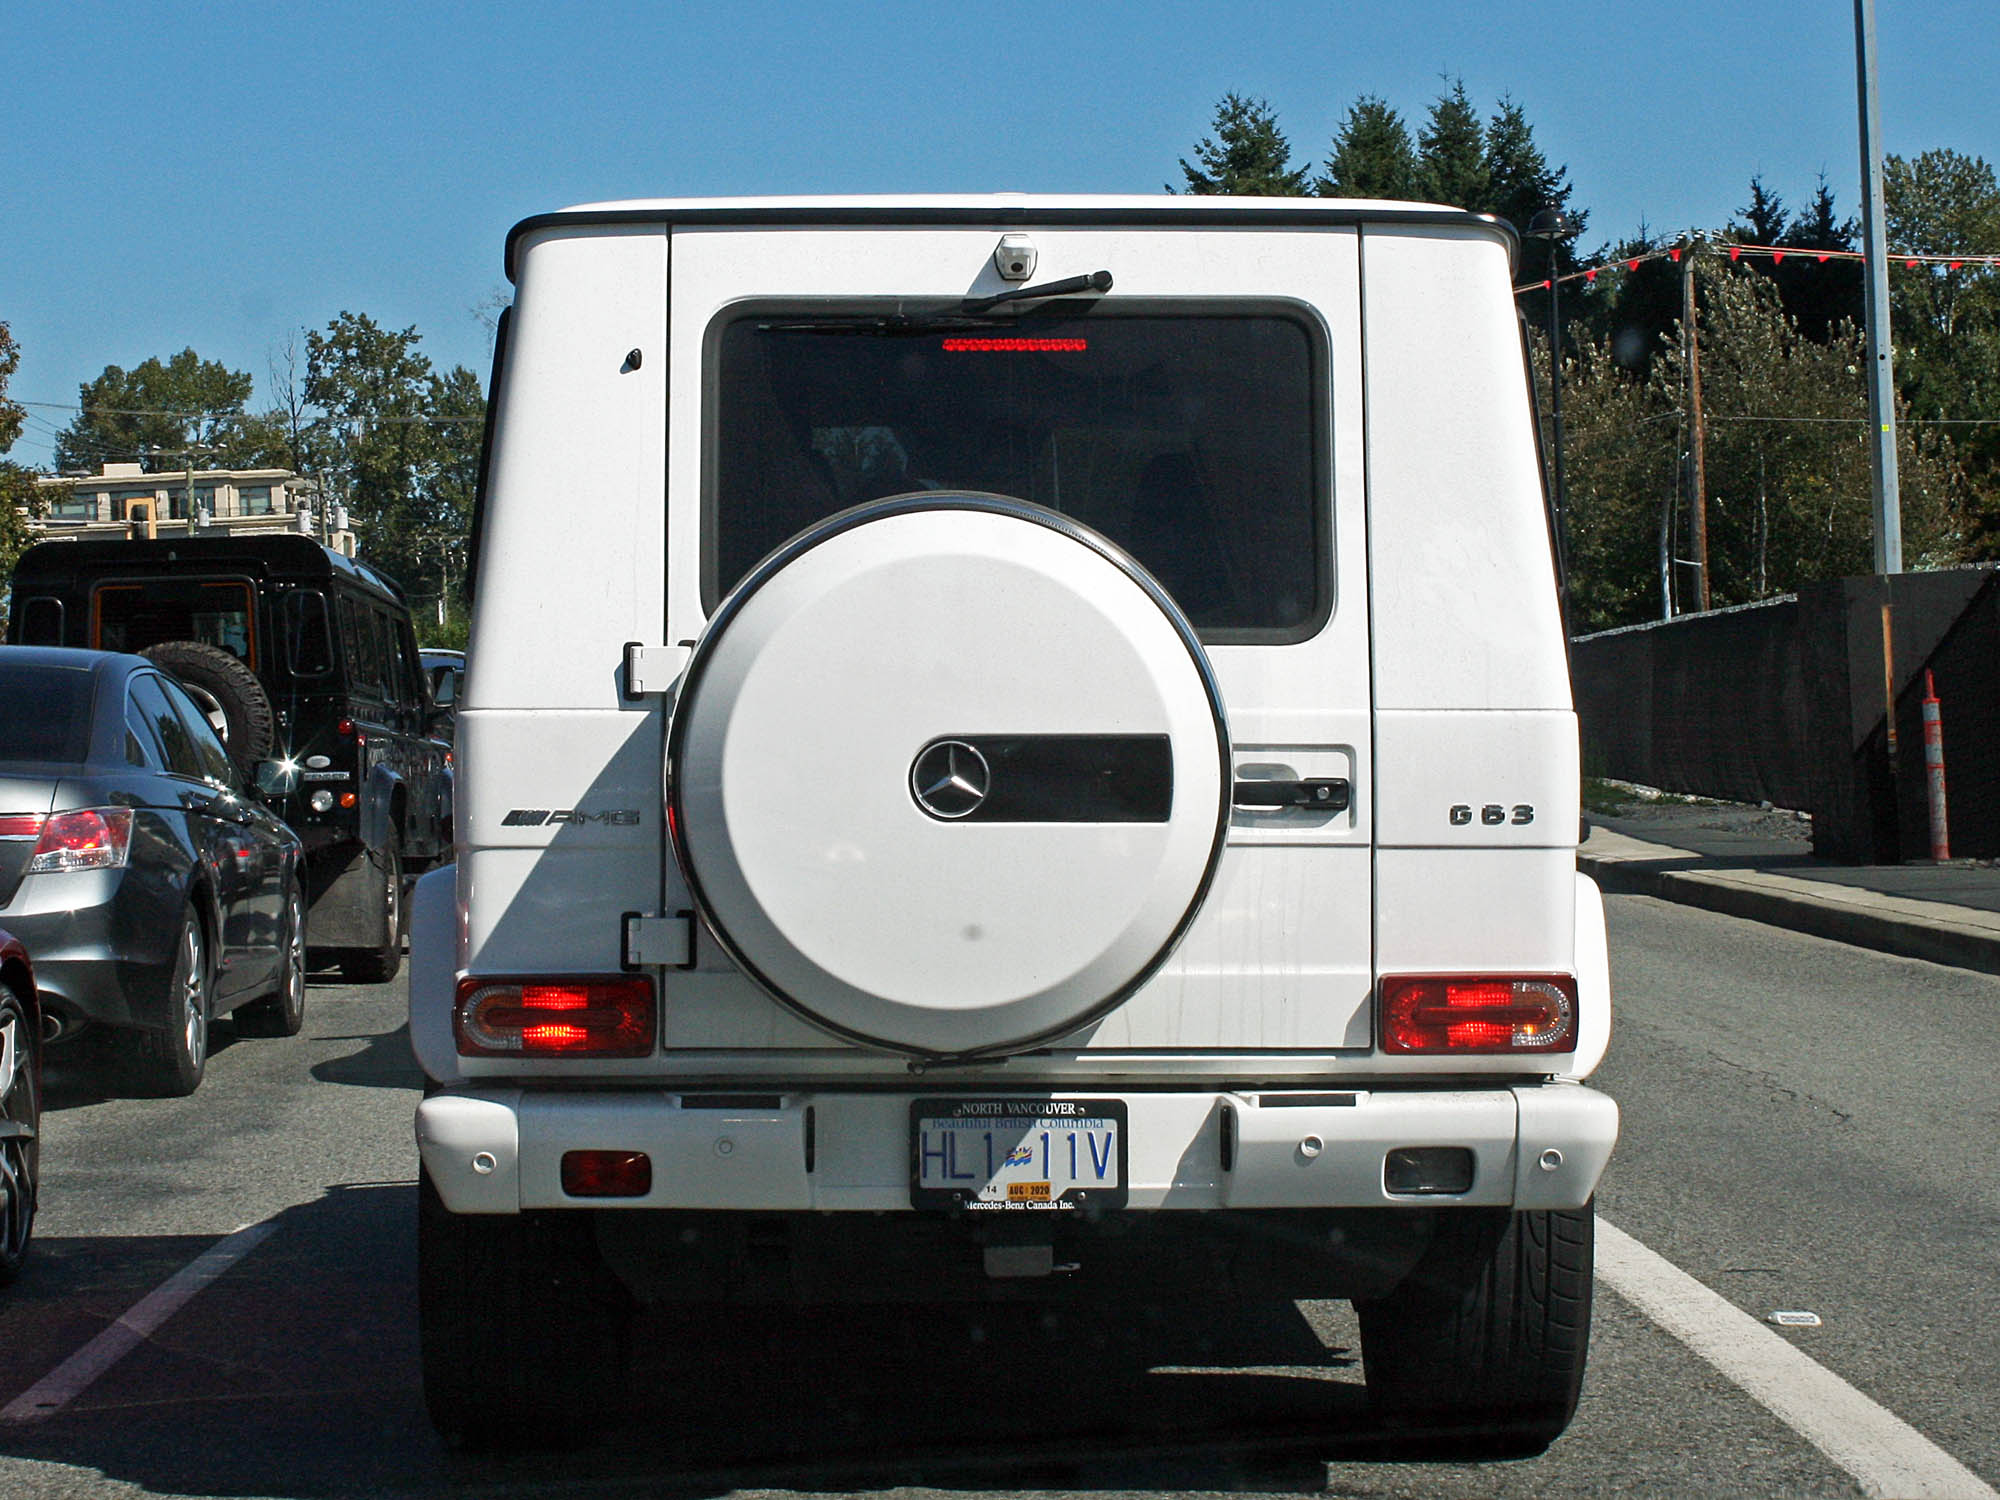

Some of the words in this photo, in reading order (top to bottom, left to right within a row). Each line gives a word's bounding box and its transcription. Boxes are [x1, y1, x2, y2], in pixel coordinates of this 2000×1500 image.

[546, 810, 640, 826] AMG
[961, 1103, 1002, 1114] NORTH
[1007, 1103, 1076, 1114] VANCOUVER
[932, 1118, 991, 1129] Beautiful
[995, 1118, 1036, 1129] British
[1040, 1118, 1104, 1129] Columbia
[921, 1131, 992, 1179] HL1
[1040, 1131, 1113, 1179] 11V
[1030, 1185, 1050, 1195] 2020
[965, 1200, 1025, 1210] Mercedes-Benz
[1026, 1200, 1058, 1210] Canada
[1059, 1200, 1075, 1210] Inc.
